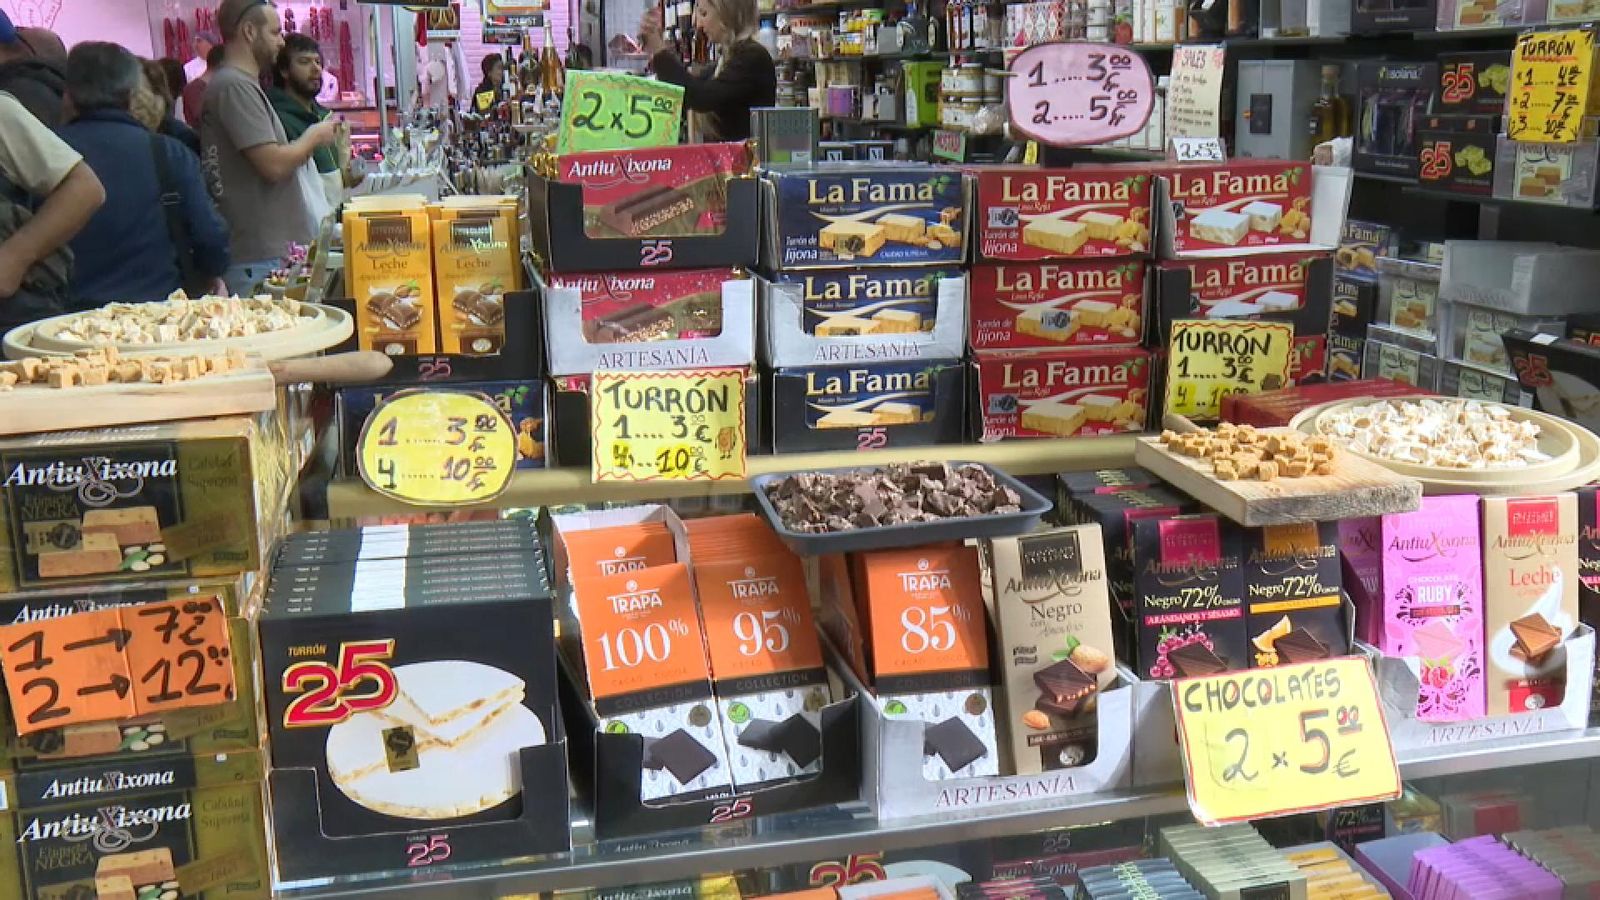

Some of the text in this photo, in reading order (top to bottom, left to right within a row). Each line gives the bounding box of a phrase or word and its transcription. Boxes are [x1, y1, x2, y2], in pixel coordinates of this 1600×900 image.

[1028, 61, 1047, 87] 1
[1442, 63, 1475, 103] 25
[572, 91, 604, 131] 2
[1032, 100, 1051, 124] 2
[1420, 141, 1452, 179] 25
[808, 178, 934, 204] La Fama
[1002, 176, 1129, 202] La Fama
[1173, 171, 1289, 197] La Fama
[640, 240, 673, 266] 25
[805, 275, 929, 300] La Fama
[996, 266, 1122, 292] La Fama
[1190, 262, 1304, 288] La Fama
[1173, 327, 1272, 356] TURRÓN
[1003, 362, 1128, 388] La Fama
[1178, 356, 1190, 378] 1
[603, 378, 728, 413] TURRÓN
[806, 370, 929, 396] La Fama
[378, 416, 398, 446] 1
[613, 414, 631, 439] 1
[857, 428, 887, 453] 25
[378, 458, 397, 489] 4
[727, 577, 779, 599] TRAPA
[897, 569, 951, 593] TRAPA
[1249, 583, 1284, 598] Negro
[1283, 573, 1322, 598] 72%
[1509, 565, 1560, 586] Leche
[606, 588, 663, 614] TRAPA
[1144, 594, 1181, 609] Negro
[1181, 585, 1222, 609] 72%
[1417, 585, 1453, 604] RUBY
[1031, 602, 1083, 621] Negro
[8, 630, 53, 672] 1
[283, 638, 396, 728] 25
[1185, 667, 1341, 713] CHOCOLATES
[22, 677, 71, 724] 2
[1222, 728, 1259, 781] 2
[710, 799, 752, 824] 25
[406, 834, 450, 867] 25
